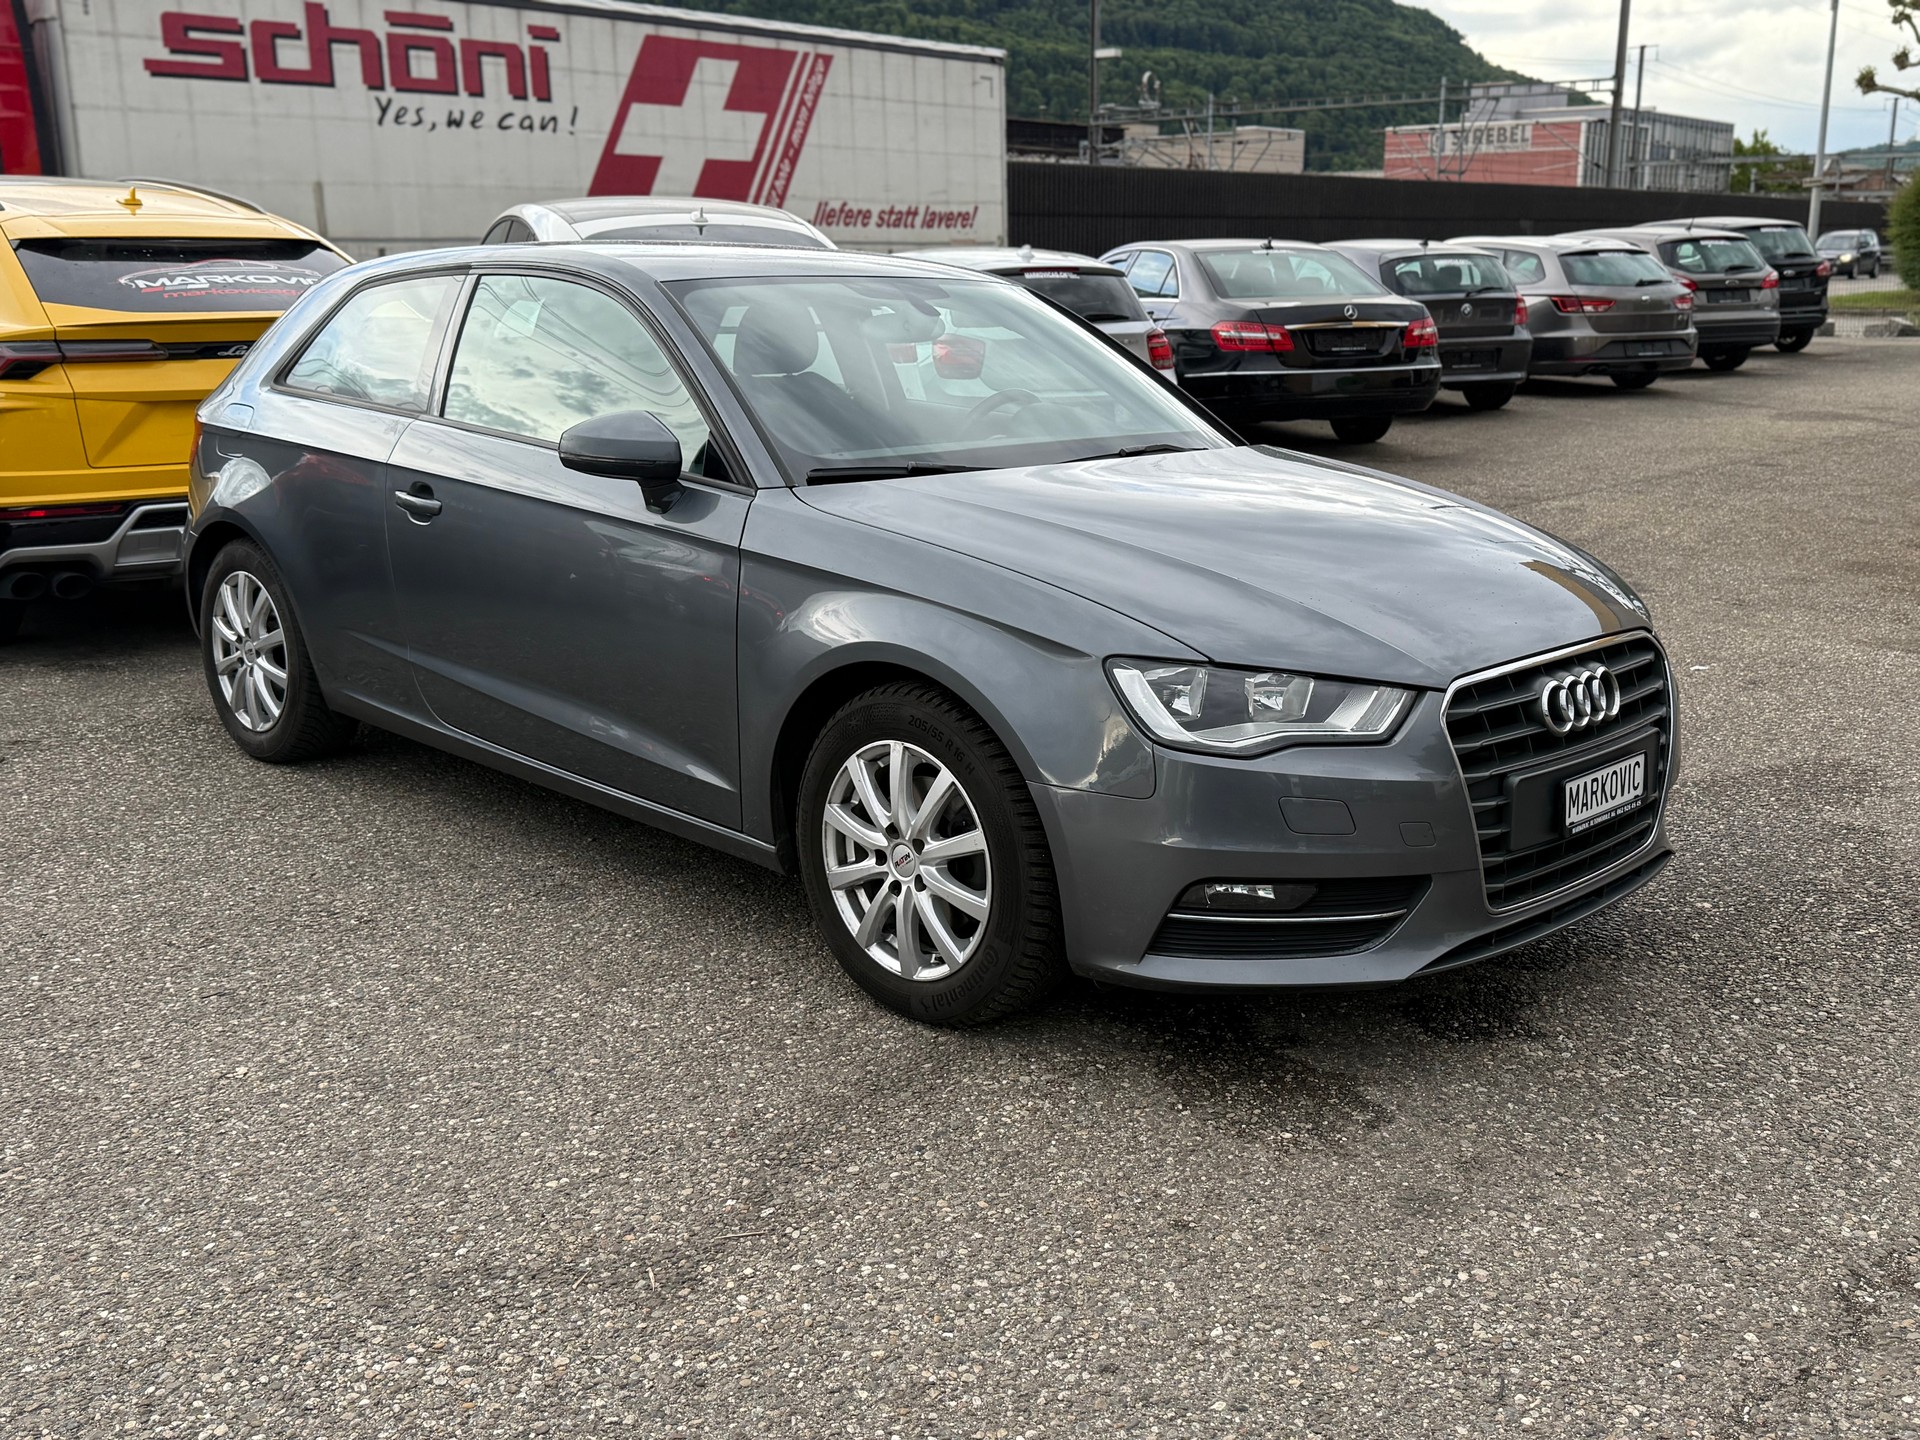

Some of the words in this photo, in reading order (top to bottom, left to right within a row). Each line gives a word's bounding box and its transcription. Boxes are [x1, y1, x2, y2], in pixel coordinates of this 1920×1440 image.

[374, 96, 437, 132] Yes,
[446, 108, 485, 130] we
[1451, 125, 1530, 147] STREBEL
[875, 205, 919, 229] statt
[920, 205, 979, 229] lavere!
[908, 714, 945, 742] 205/55
[945, 739, 954, 752] R
[953, 747, 966, 762] 16
[1568, 760, 1641, 819] MARKOVIC
